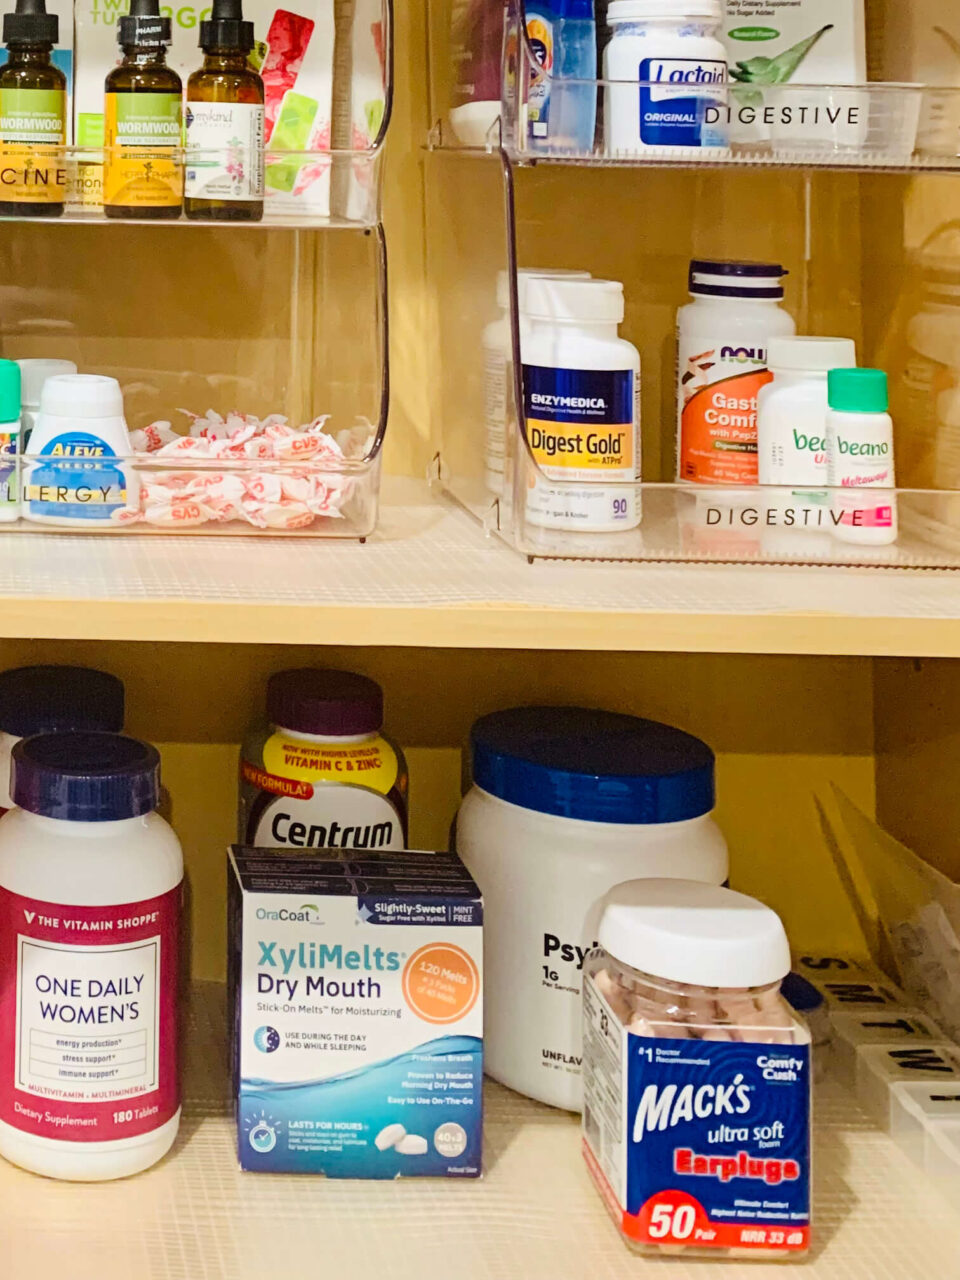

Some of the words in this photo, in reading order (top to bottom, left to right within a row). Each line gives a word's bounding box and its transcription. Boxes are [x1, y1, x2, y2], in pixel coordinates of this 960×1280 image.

[644, 113, 695, 123] ORIGINAL
[704, 106, 860, 124] DIGESTIVE
[0, 118, 62, 130] WORMWOOD
[117, 122, 179, 134] WORMWOOD
[531, 393, 605, 408] ENZYMEDICA
[292, 437, 318, 451] CVS
[532, 428, 583, 455] Digest
[586, 434, 621, 454] Gold
[837, 435, 888, 456] beano
[613, 499, 627, 513] 90
[706, 508, 864, 527] DIGESTIVE
[284, 754, 331, 771] VITAMIN
[335, 761, 343, 771] C
[346, 761, 354, 771] &
[257, 773, 307, 797] FORMULA!
[272, 812, 393, 849] Centrum
[256, 908, 310, 922] OraCoat
[375, 903, 446, 915] Slightly-Sweet
[38, 916, 59, 928] THE
[63, 919, 113, 931] VITAMIN
[117, 914, 156, 929] SHOPPE
[258, 941, 400, 974] XyliMelts
[35, 975, 81, 997] ONE
[88, 974, 144, 997] DAILY
[258, 973, 298, 1001] Dry
[306, 976, 381, 998] Mouth
[39, 1001, 139, 1024] WOMEN'S
[257, 1002, 296, 1014] Stick-On
[331, 1006, 344, 1015] for
[346, 1007, 402, 1018] Moisturizing
[56, 1038, 80, 1048] energy
[285, 1032, 300, 1040] USE
[301, 1033, 332, 1041] DURING
[334, 1034, 348, 1042] THE
[350, 1034, 367, 1042] DAY
[304, 1042, 328, 1050] WHILE
[330, 1043, 367, 1052] SLEEPING
[756, 1056, 803, 1070] Comfy
[59, 1069, 87, 1078] immune
[762, 1069, 797, 1081] Cush
[28, 1083, 85, 1098] MULTIVITAMIN
[91, 1084, 147, 1098] MULTIMINERAL
[416, 1097, 430, 1105] Use
[14, 1101, 43, 1122] Dietary
[45, 1111, 98, 1127] Supplement
[113, 1110, 133, 1124] 180
[134, 1104, 159, 1120] Tablets
[288, 1121, 314, 1130] LASTS
[708, 1124, 748, 1143] ultra
[753, 1120, 784, 1140] soft
[759, 1141, 780, 1149] foam
[674, 1147, 800, 1185] Earplugs
[648, 1204, 696, 1239] 50
[695, 1229, 716, 1240] Pair
[740, 1230, 766, 1243] NRR
[768, 1232, 784, 1244] 33
